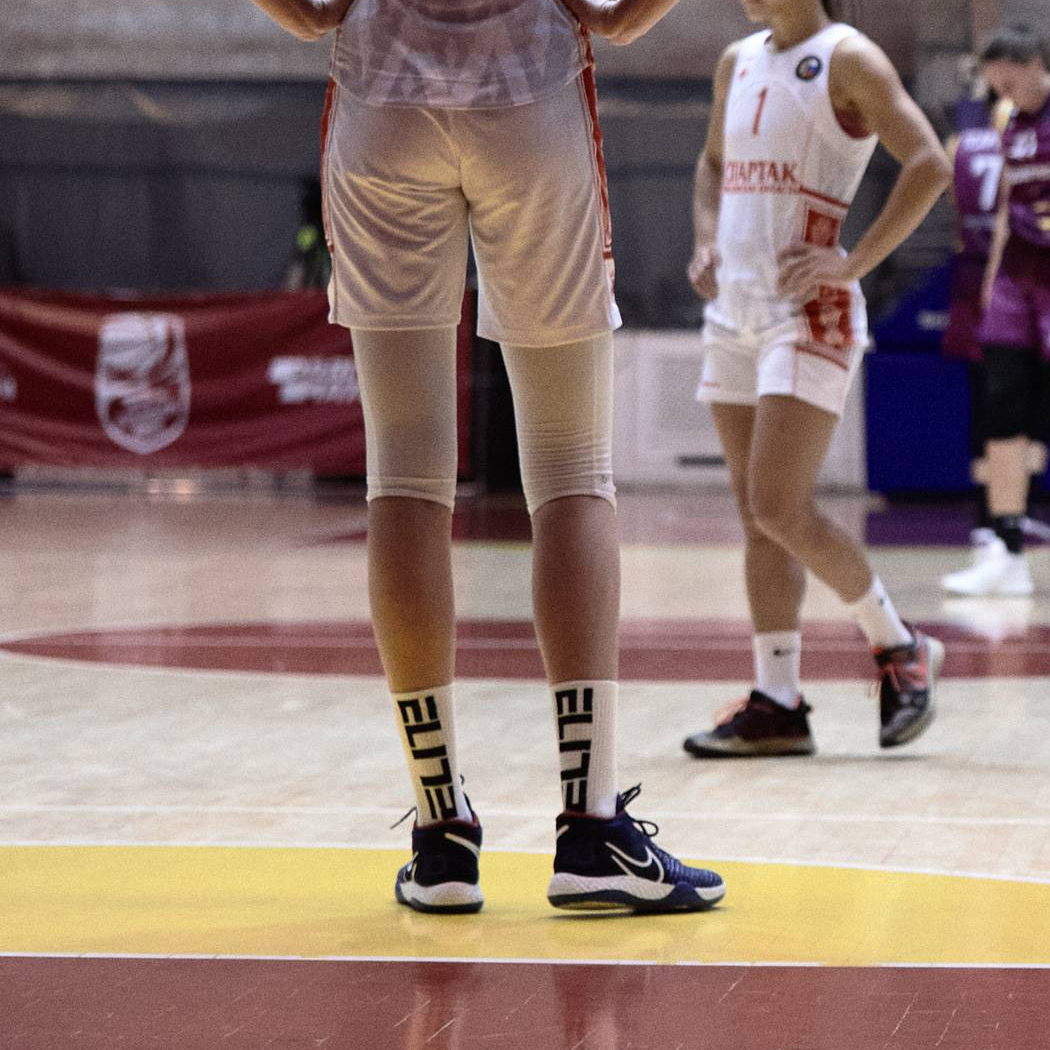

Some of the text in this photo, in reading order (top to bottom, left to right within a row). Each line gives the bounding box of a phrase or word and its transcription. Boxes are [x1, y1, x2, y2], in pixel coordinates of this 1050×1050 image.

[752, 86, 768, 136] 1
[969, 153, 1005, 213] 7
[397, 695, 458, 819] ELITE
[555, 688, 593, 812] ELITE
